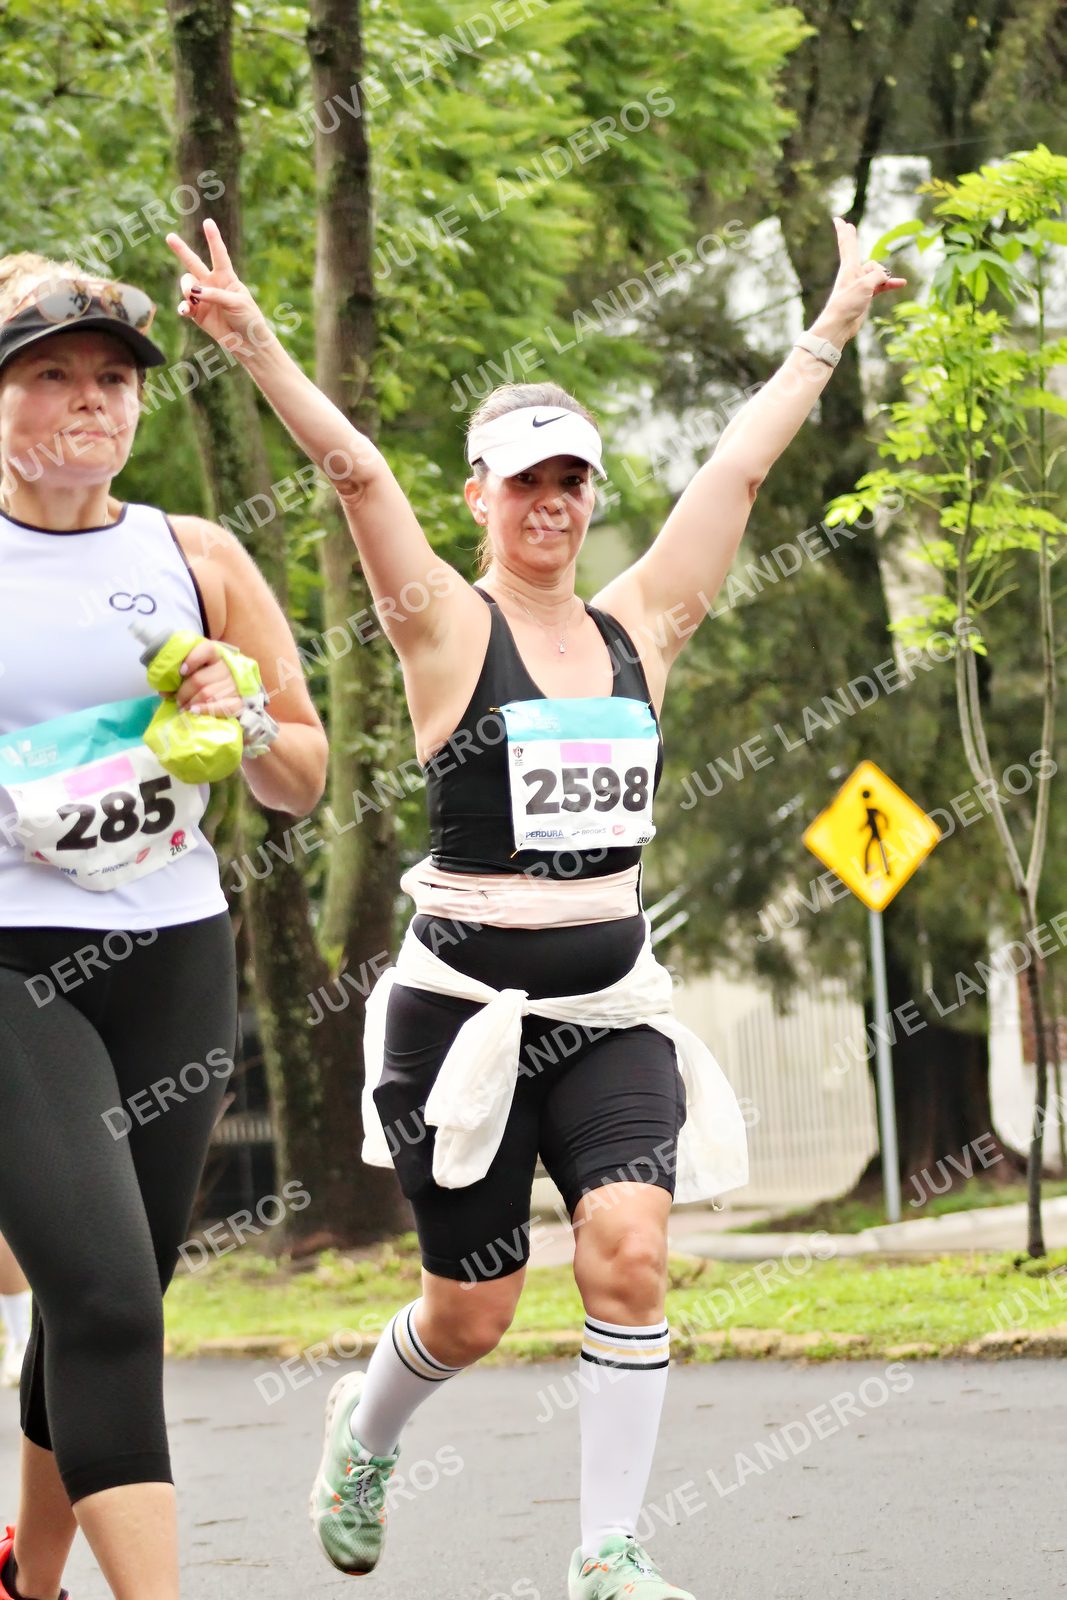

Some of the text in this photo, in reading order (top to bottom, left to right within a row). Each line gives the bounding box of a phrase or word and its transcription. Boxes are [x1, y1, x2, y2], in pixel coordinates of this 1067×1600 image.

[56, 774, 175, 851] 285
[522, 766, 649, 815] 2598
[526, 829, 564, 839] PERDURA
